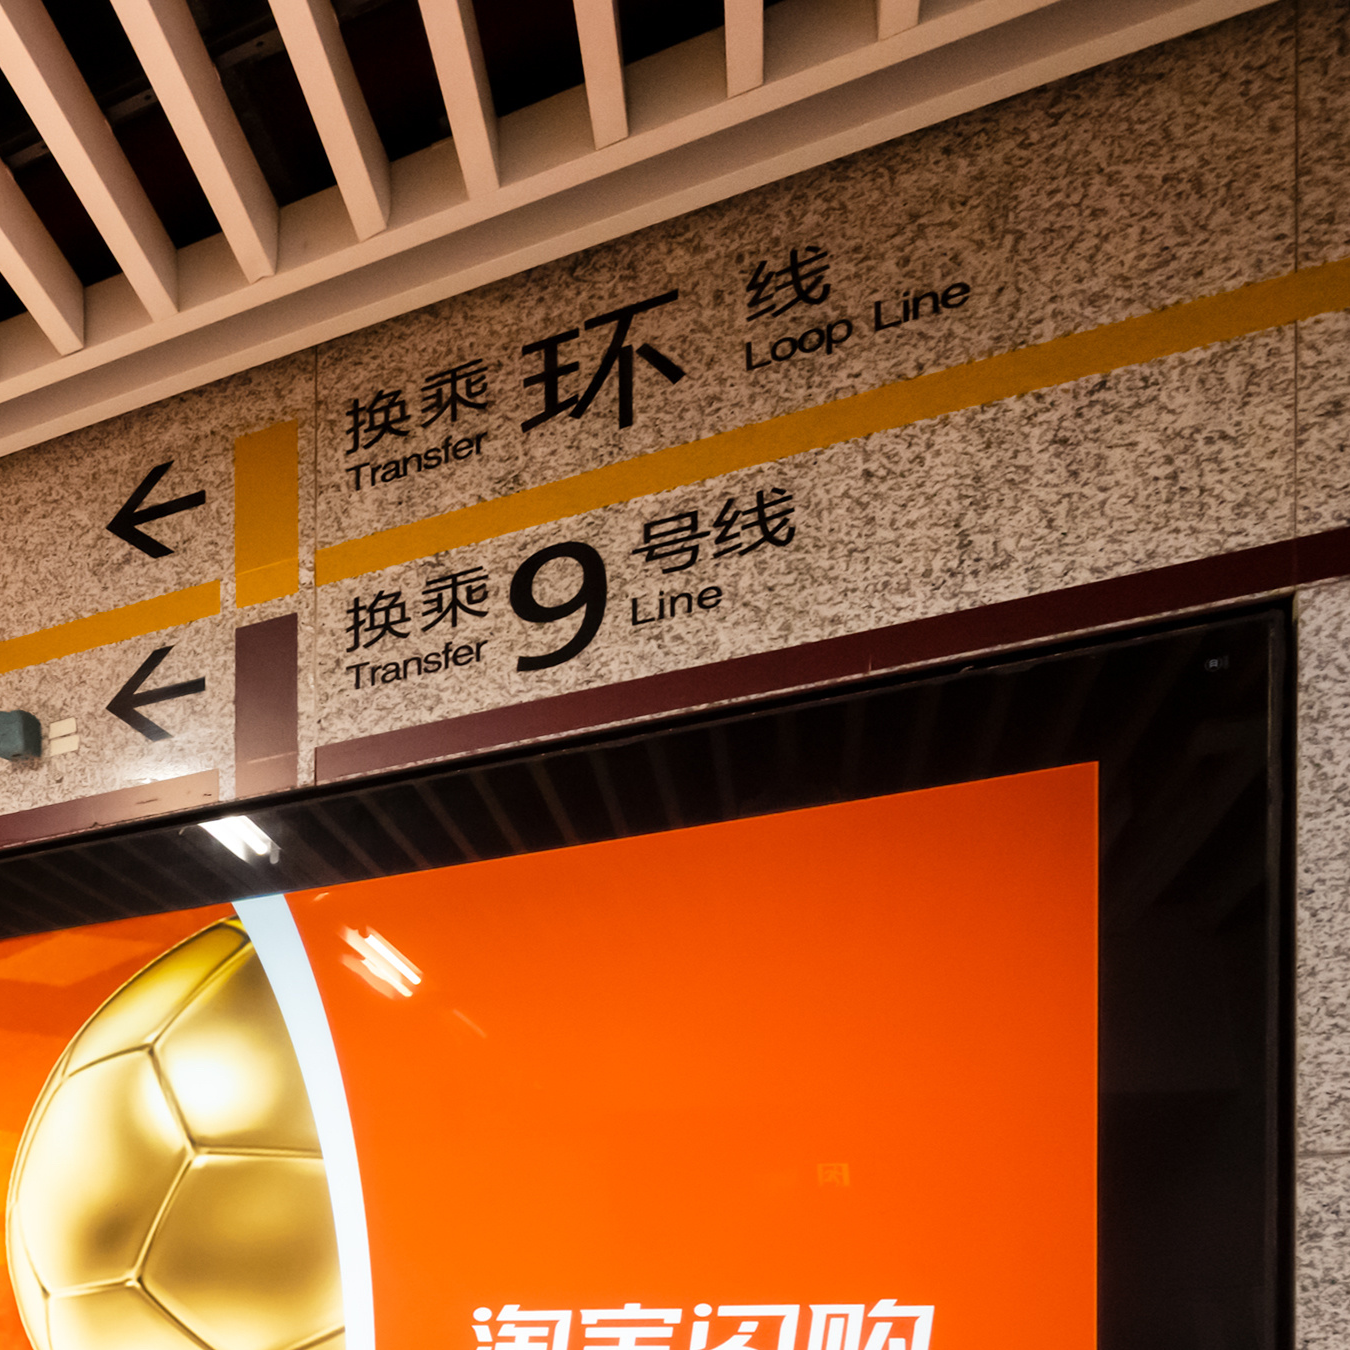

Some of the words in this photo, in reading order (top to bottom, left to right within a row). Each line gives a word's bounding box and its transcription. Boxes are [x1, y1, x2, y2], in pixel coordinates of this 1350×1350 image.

[345, 358, 488, 454] 换乘
[520, 288, 686, 434] 环
[744, 245, 831, 322] 线
[745, 315, 853, 370] Loop
[874, 281, 972, 331] Line
[346, 427, 488, 493] Transfer
[345, 565, 489, 653] 换乘
[509, 541, 608, 673] 9
[631, 487, 796, 577] 号线
[630, 581, 723, 627] Line
[346, 637, 488, 691] Transfer
